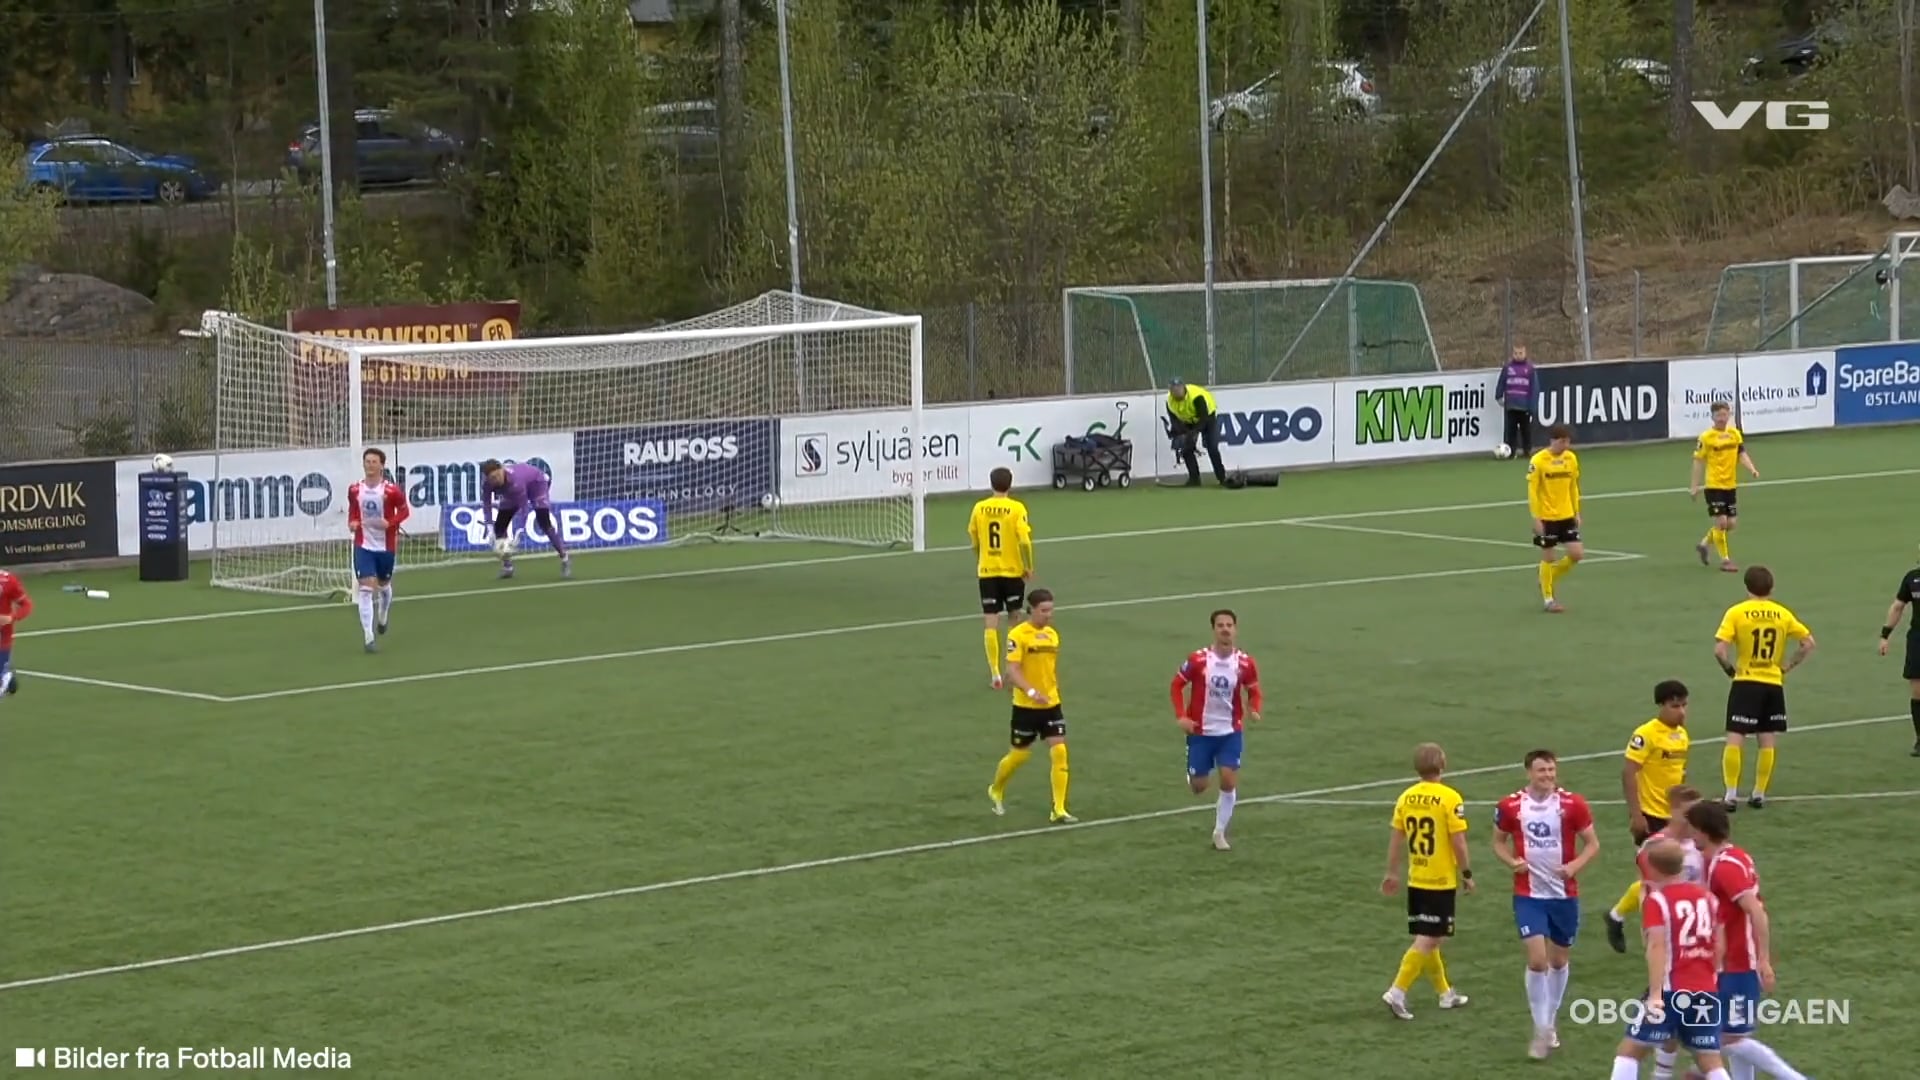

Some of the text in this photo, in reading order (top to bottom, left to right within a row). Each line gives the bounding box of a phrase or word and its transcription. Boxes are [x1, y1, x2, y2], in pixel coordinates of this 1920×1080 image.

[1840, 360, 1920, 392] SpareBa
[1448, 383, 1485, 411] mini
[1685, 385, 1801, 404] Raufoss elektro as
[1216, 406, 1323, 446] AXBO
[1355, 385, 1443, 445] KIWI
[1448, 411, 1480, 443] pris
[624, 436, 738, 465] RAUFOSS
[998, 427, 1042, 462] GK
[0, 481, 86, 513] RDVIK
[186, 471, 333, 524] ammo
[624, 483, 738, 501] TECHNOLOGY
[525, 506, 658, 543] OBOS
[989, 521, 1000, 549] 6
[1744, 610, 1781, 620] TOTEN
[1751, 627, 1777, 660] 13
[1404, 793, 1441, 806] TOTEN
[1406, 816, 1435, 856] 23
[1675, 898, 1712, 946] 24
